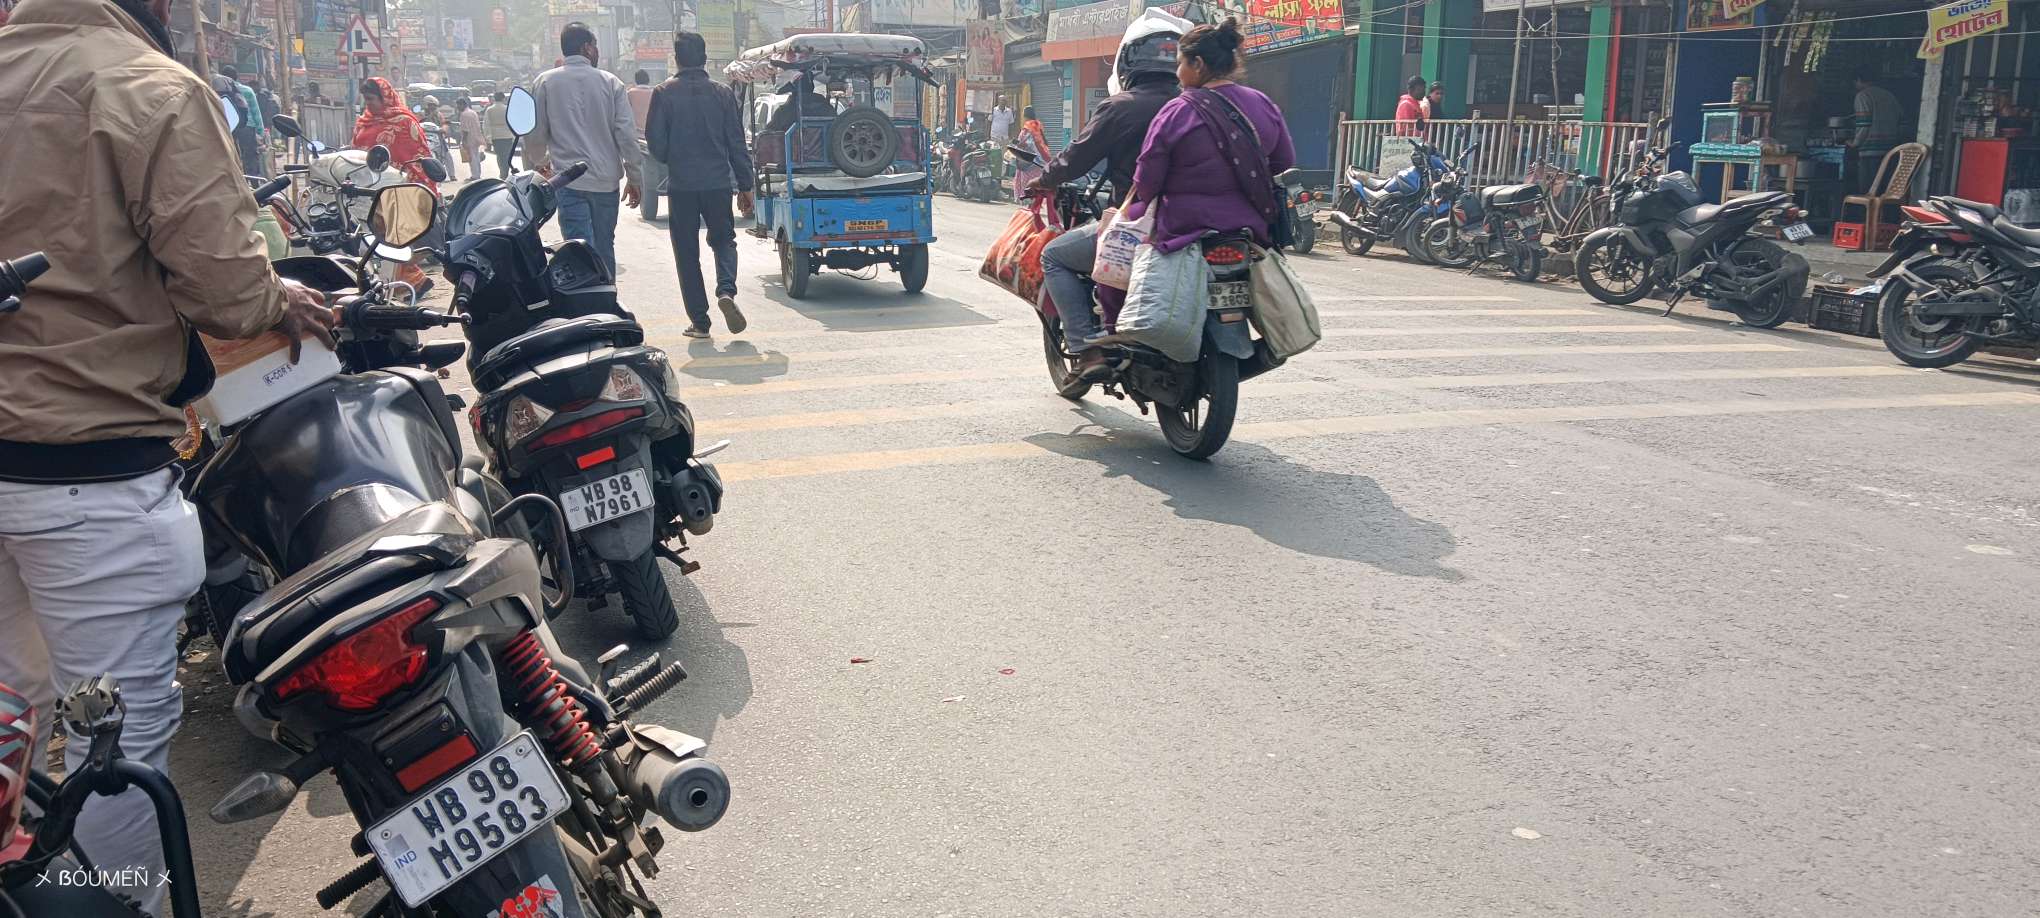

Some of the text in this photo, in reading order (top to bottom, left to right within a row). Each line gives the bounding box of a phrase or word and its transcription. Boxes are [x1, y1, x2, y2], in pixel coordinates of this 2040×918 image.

[1936, 9, 2003, 43] হোটেল
[581, 475, 633, 504] WB 98
[584, 490, 641, 523] N7961
[412, 755, 519, 839] WB 98
[428, 785, 548, 880] M9583
[393, 850, 418, 869] IND
